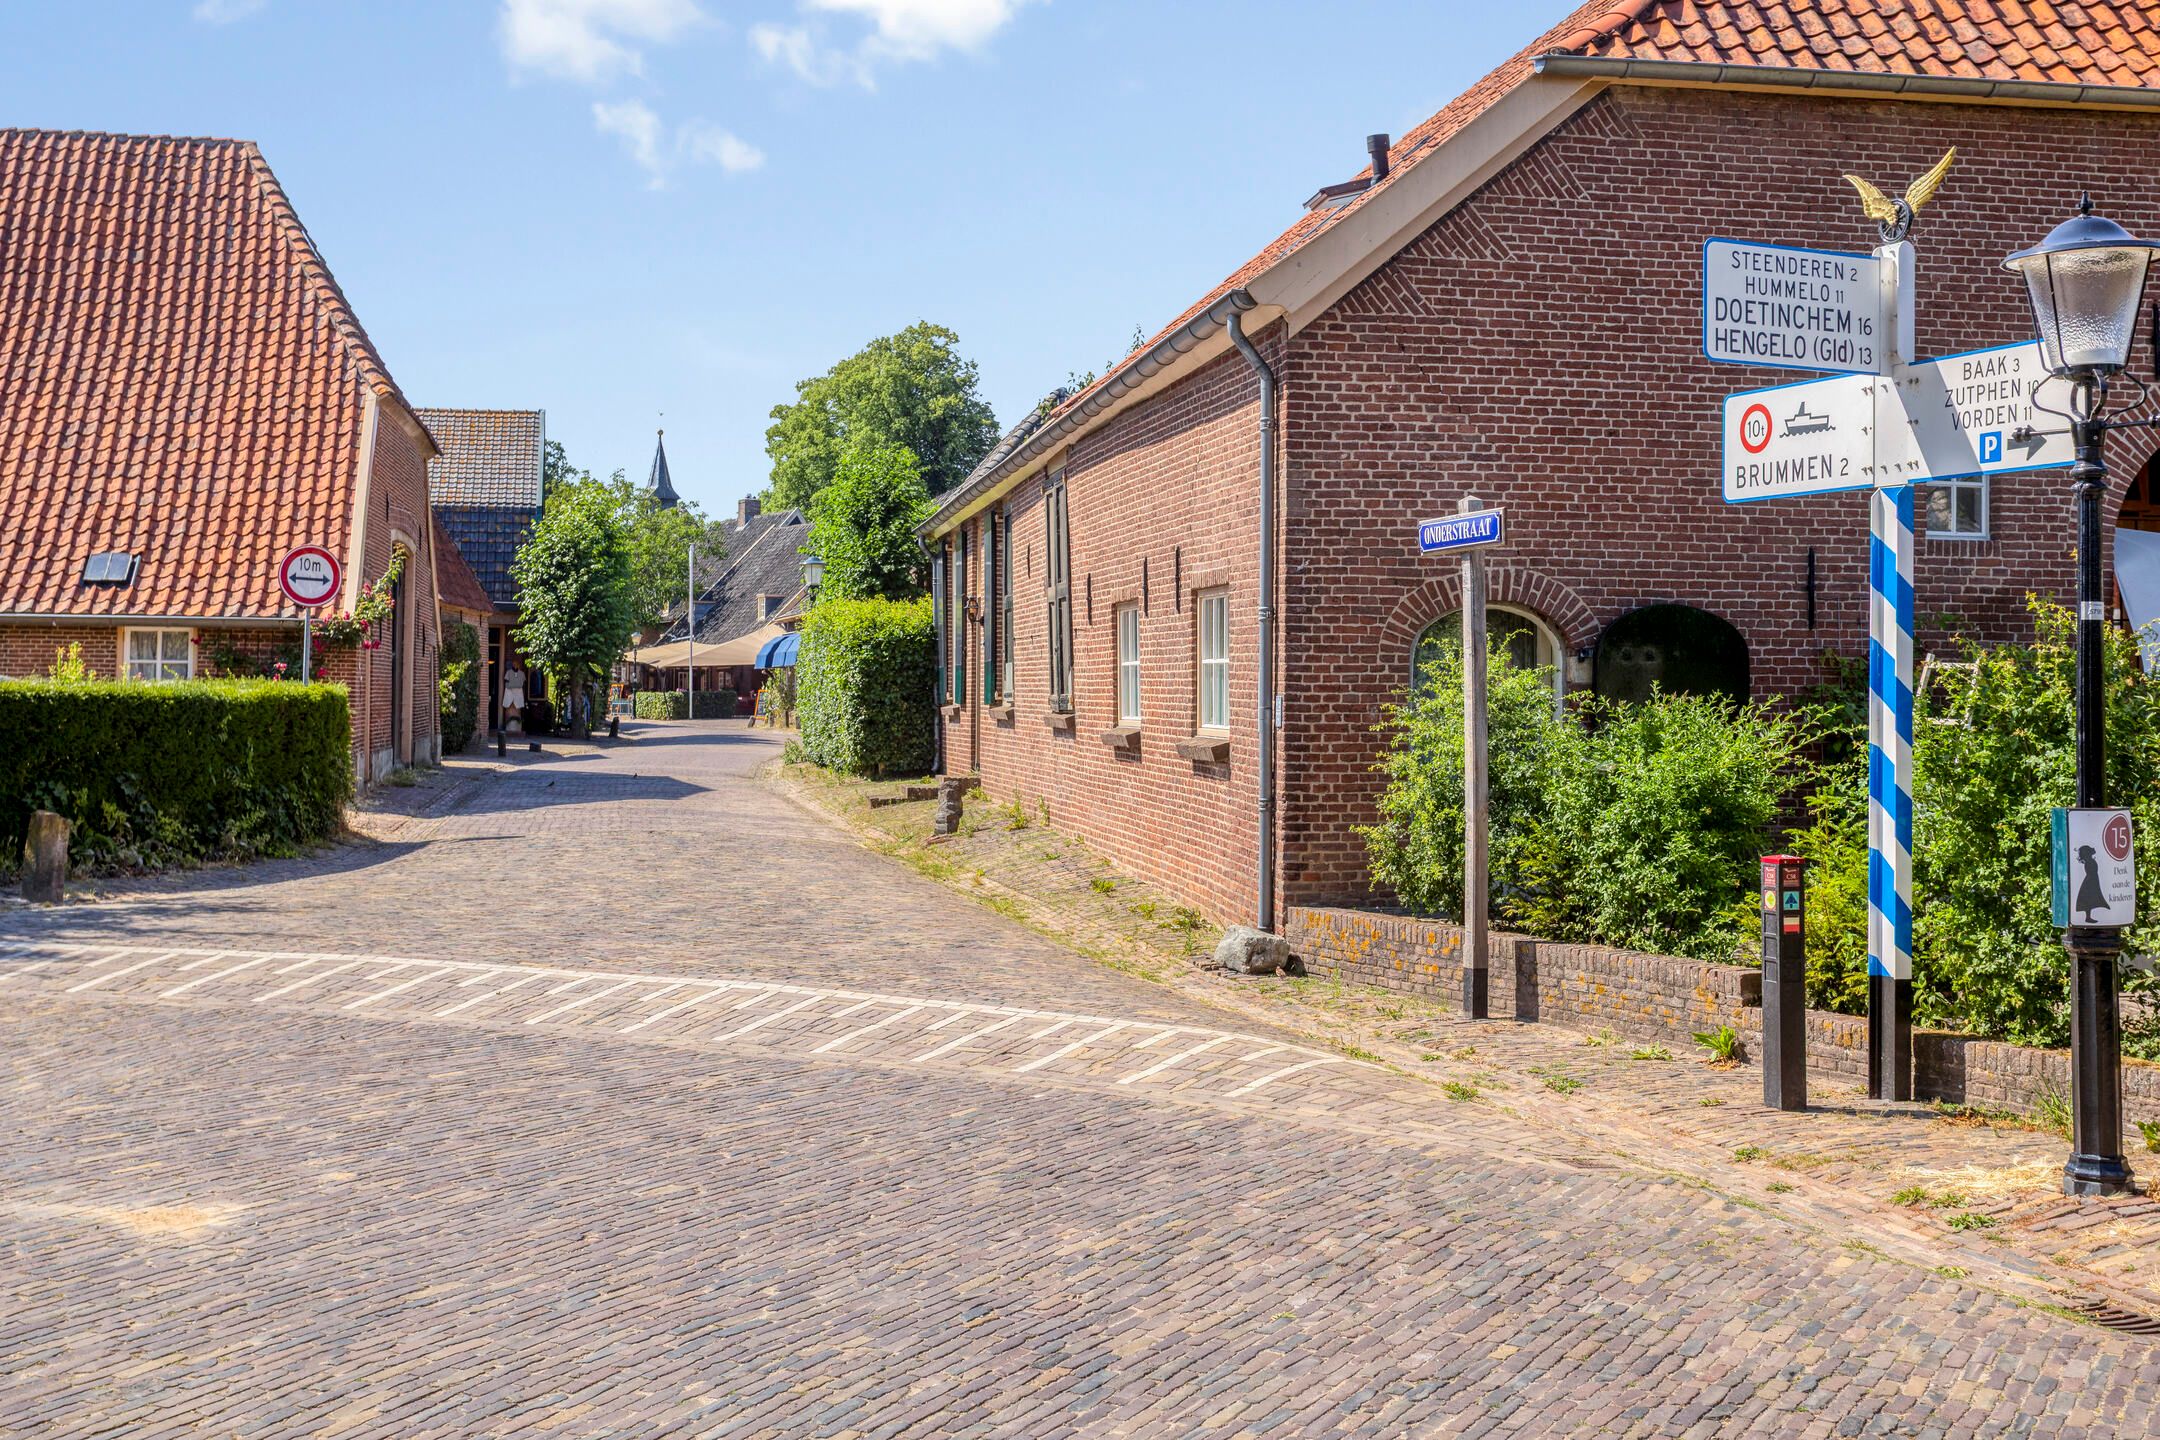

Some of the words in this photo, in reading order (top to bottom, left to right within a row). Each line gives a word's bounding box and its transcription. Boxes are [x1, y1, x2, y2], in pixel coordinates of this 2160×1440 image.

[1731, 251, 1845, 281] STEENDEREN
[1850, 267, 1858, 282] 2
[1745, 276, 1830, 303] HUMMELO
[1835, 290, 1845, 304] 11
[1715, 297, 1852, 334] DOETINCHEM
[1858, 317, 1873, 336] 16
[1714, 327, 1806, 359] HENGELO
[1813, 335, 1855, 365] (Gld)
[1858, 347, 1873, 365] 13
[1963, 355, 2007, 381] BAAK
[2012, 358, 2020, 373] 3
[1945, 378, 2020, 408] ZUTPHEN
[1952, 403, 2018, 431] VORDEN
[2024, 406, 2032, 421] 11
[1736, 454, 1833, 489] BRUMMEN
[1840, 458, 1849, 477] 2
[1424, 518, 1491, 544] ONDERSTRAAT
[2112, 827, 2128, 849] 15
[2113, 866, 2128, 875] Denk
